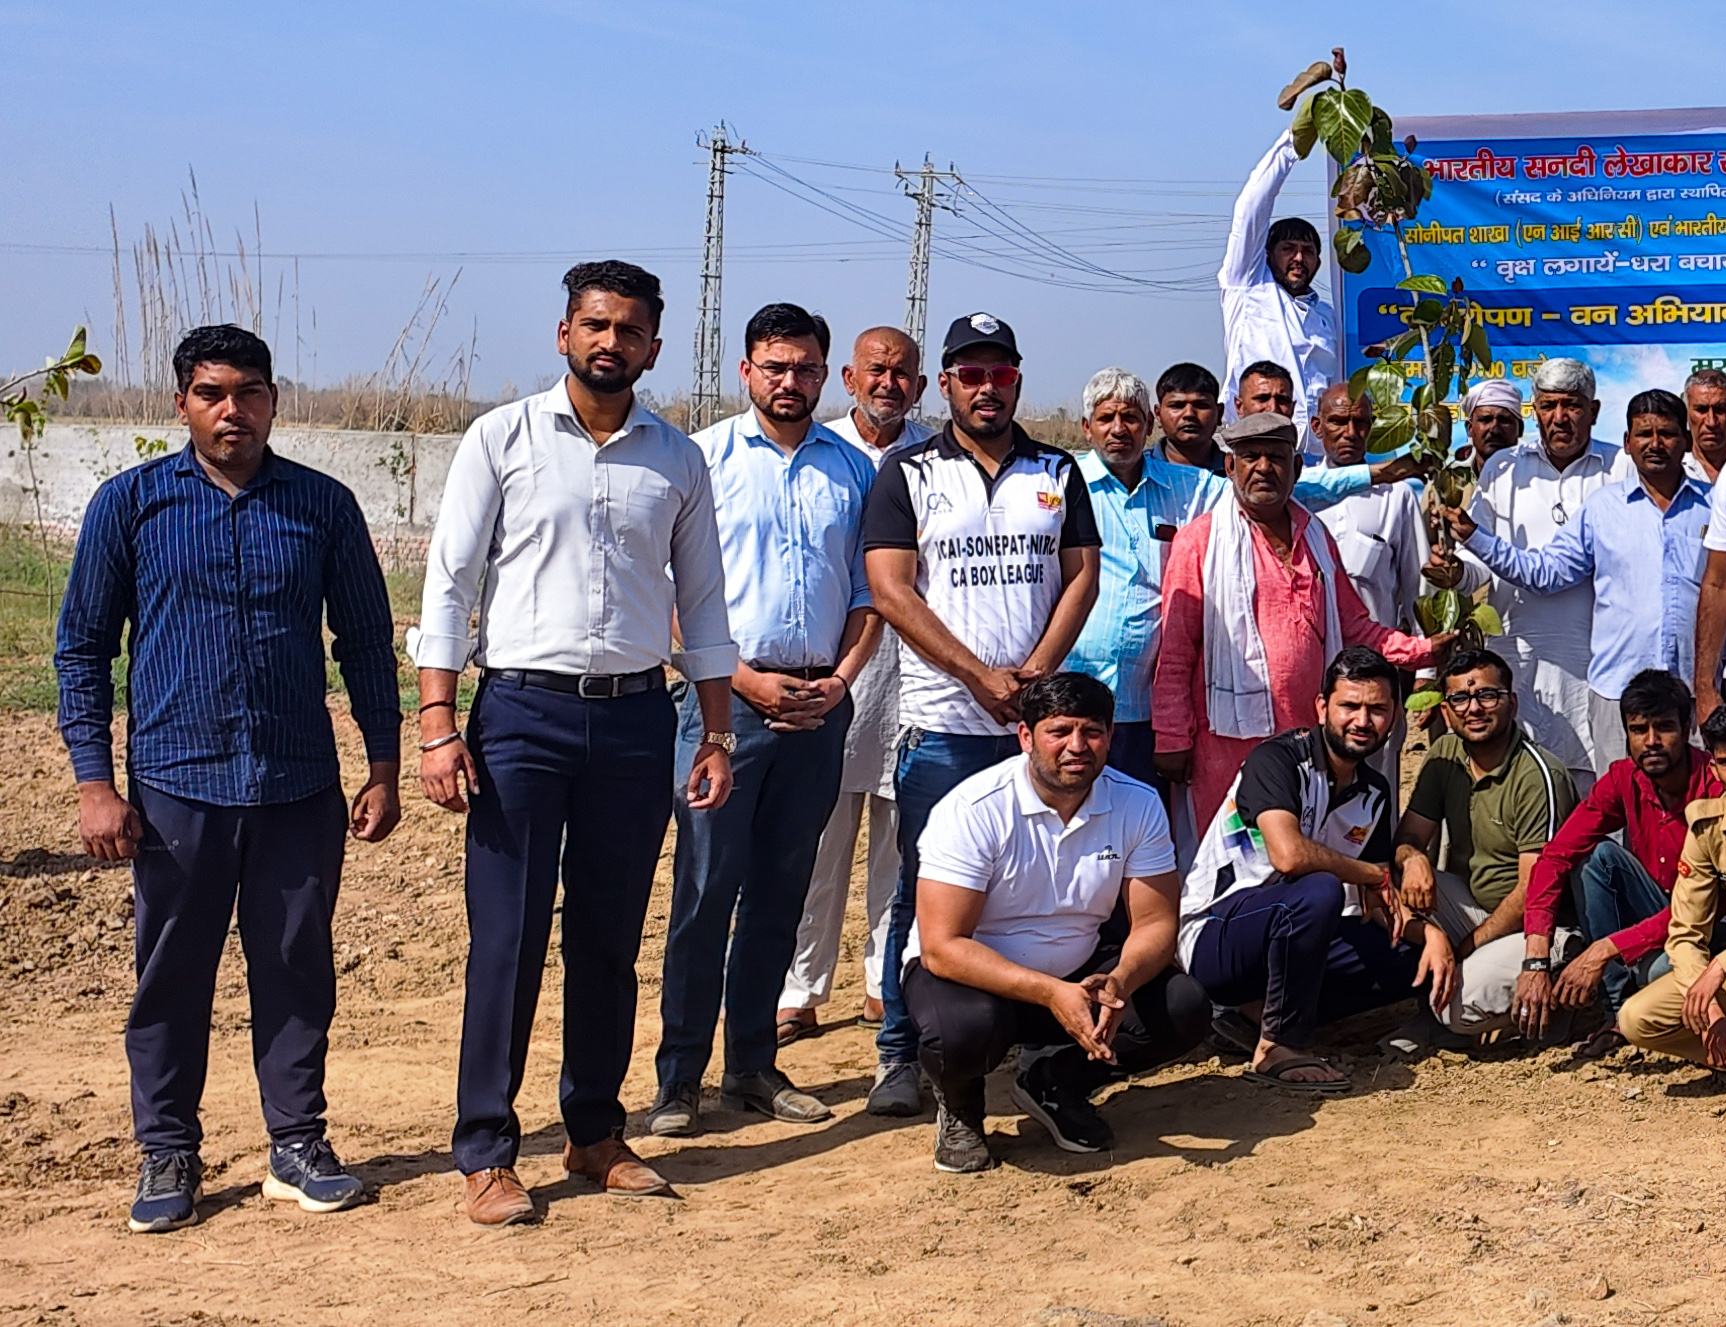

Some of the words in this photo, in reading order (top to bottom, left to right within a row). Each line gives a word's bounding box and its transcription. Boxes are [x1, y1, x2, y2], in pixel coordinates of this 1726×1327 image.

[1424, 147, 1517, 181] भारतीय
[1523, 145, 1597, 180] सनदी
[1602, 145, 1715, 178] लेखाकार
[1495, 190, 1541, 208] (संसद
[1547, 188, 1562, 203] के
[1567, 186, 1641, 202] अधिनियम
[1646, 187, 1675, 202] द्वारा
[1404, 220, 1465, 244] सोनीपत
[1469, 225, 1509, 243] शाखा
[1515, 218, 1546, 248] (एन
[1550, 215, 1582, 243] आई
[1649, 213, 1673, 238] एवं
[1496, 258, 1537, 284] वृक्ष
[1569, 304, 1619, 327] वन
[926, 491, 954, 511] CA
[934, 533, 1056, 562] ICAI-SONEPAT-NIRC
[951, 566, 968, 589] CA
[971, 564, 998, 587] BOX
[1000, 562, 1045, 586] LEAGUE
